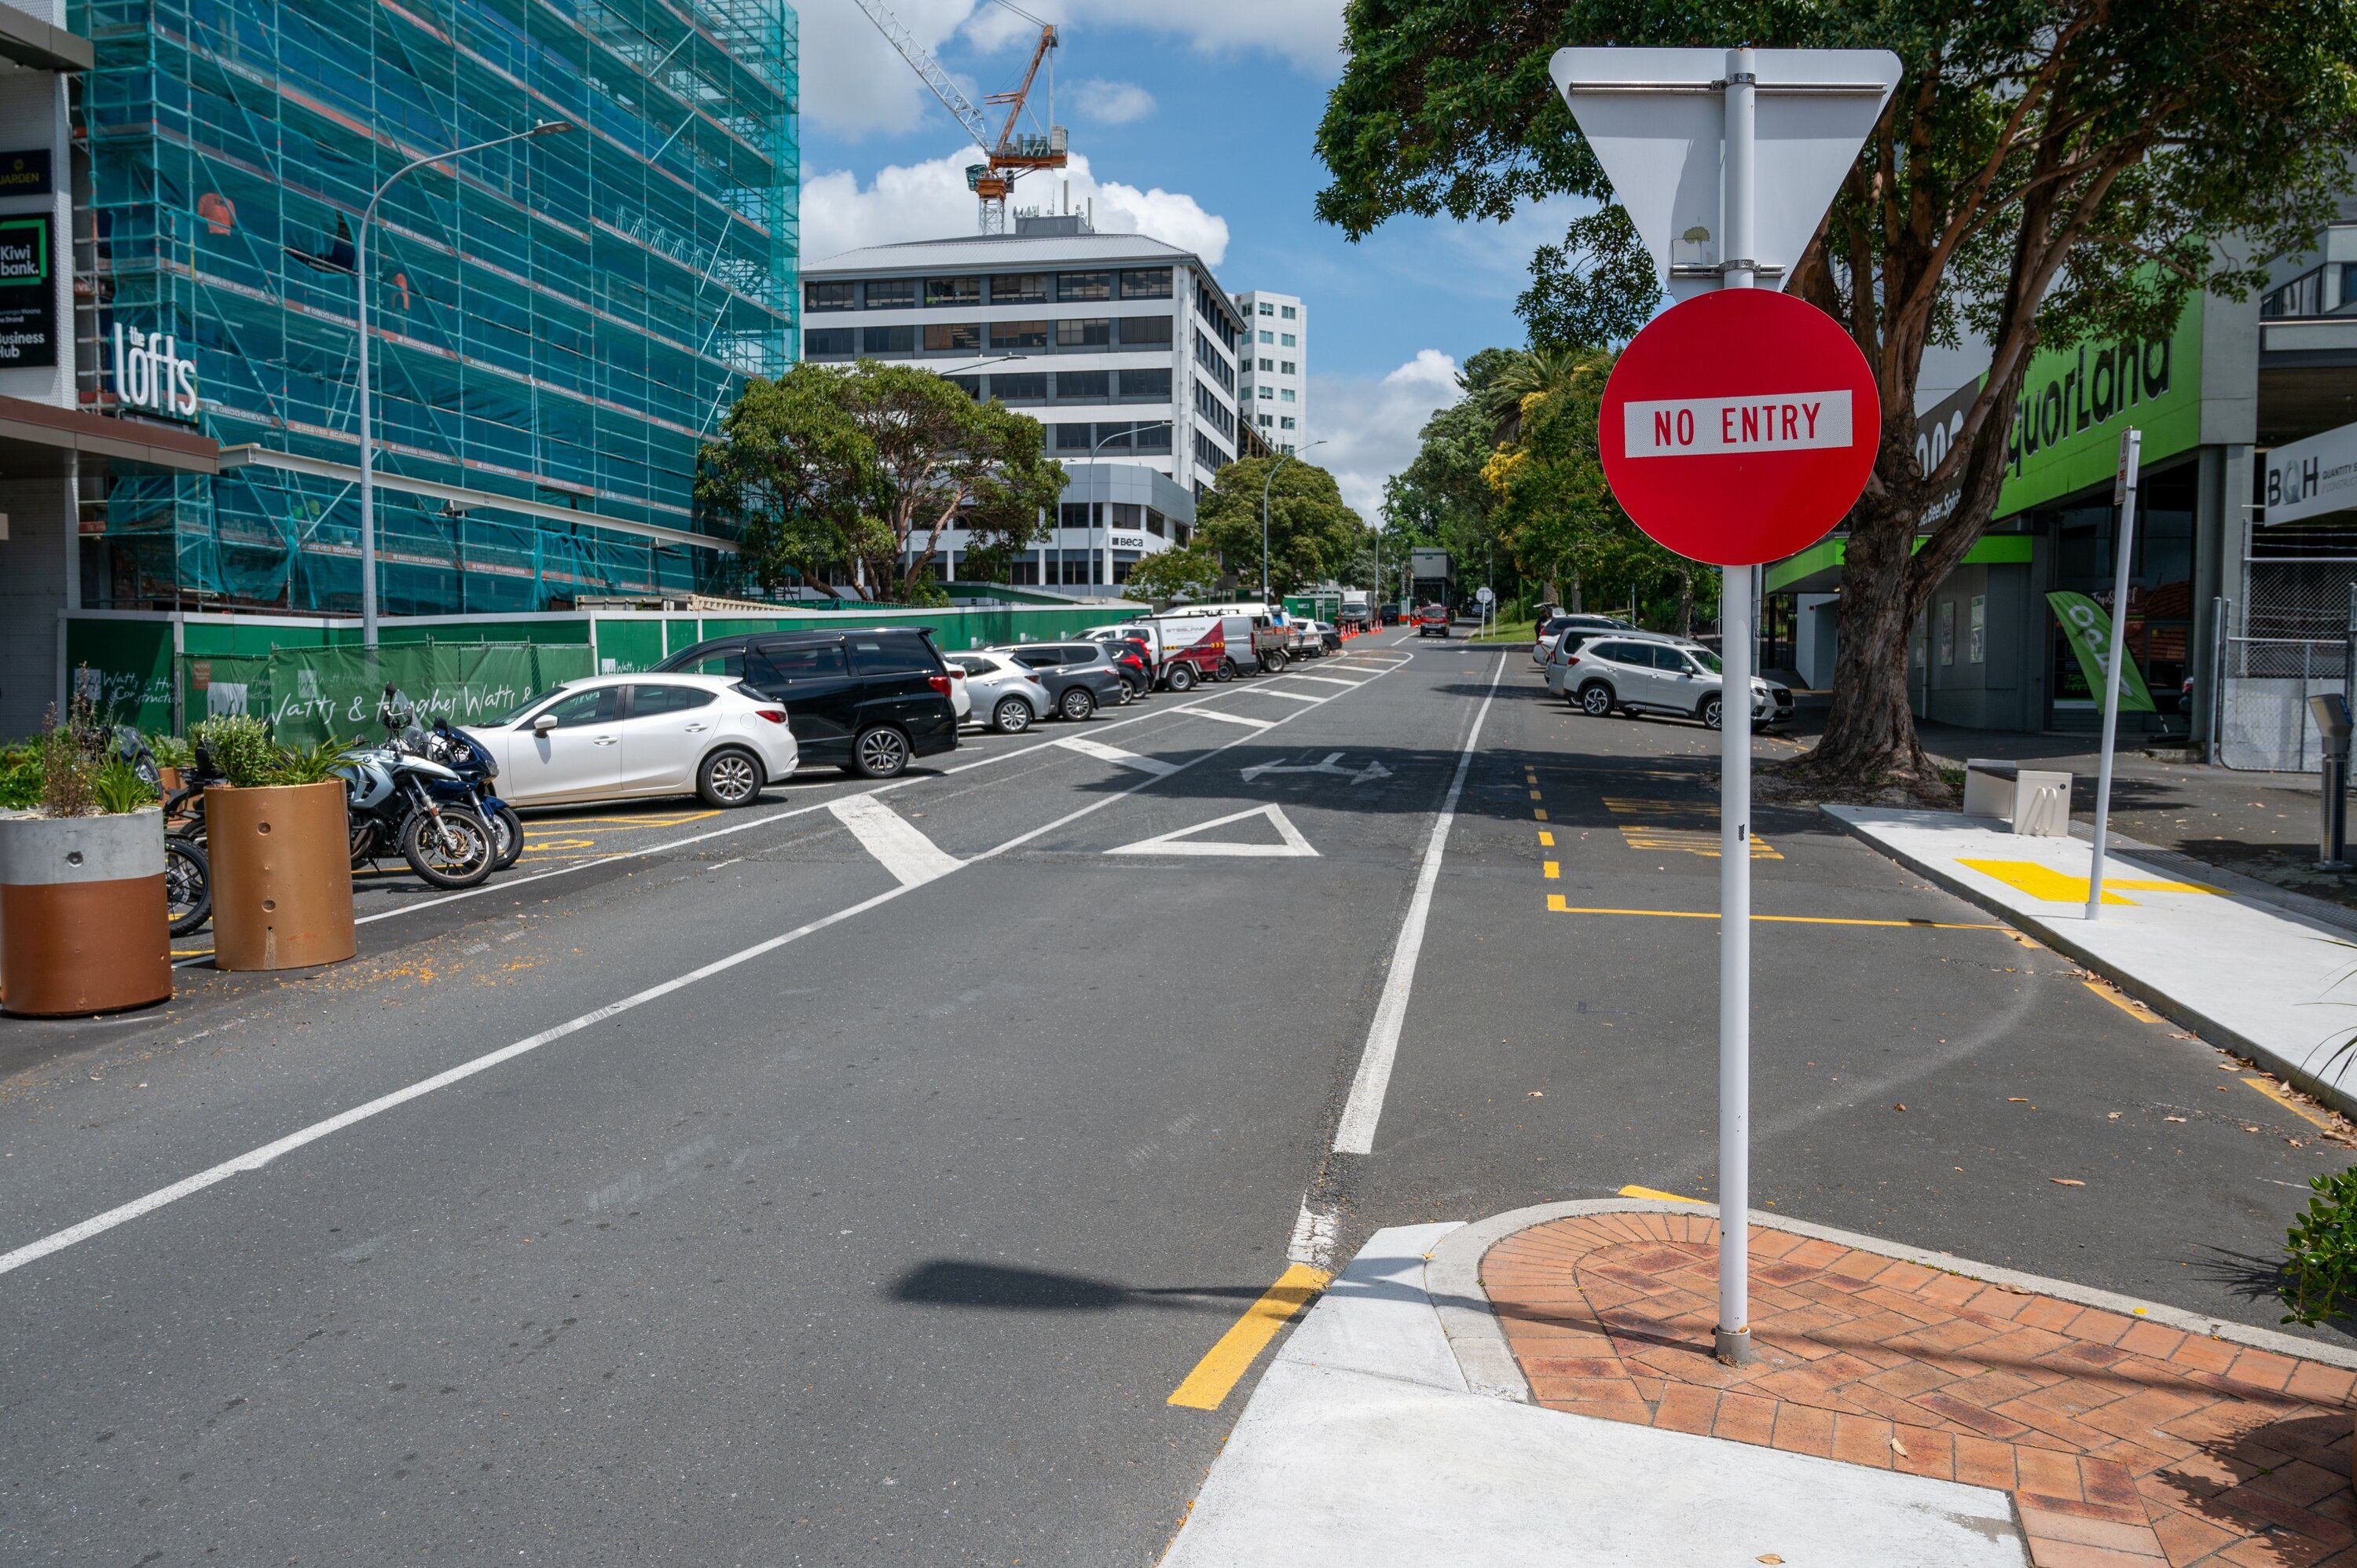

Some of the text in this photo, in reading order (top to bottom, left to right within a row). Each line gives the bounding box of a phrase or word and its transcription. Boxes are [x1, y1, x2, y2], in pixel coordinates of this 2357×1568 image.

[1, 244, 31, 260] Kiwi
[1, 260, 39, 275] bank.
[0, 332, 45, 344] usiness
[129, 325, 145, 347] the
[114, 321, 196, 416] lofts
[1655, 403, 1820, 446] NO ENTRY
[2268, 456, 2319, 507] BQH
[1120, 537, 1143, 547] Beca
[348, 696, 367, 721] &
[464, 684, 515, 717] Watts
